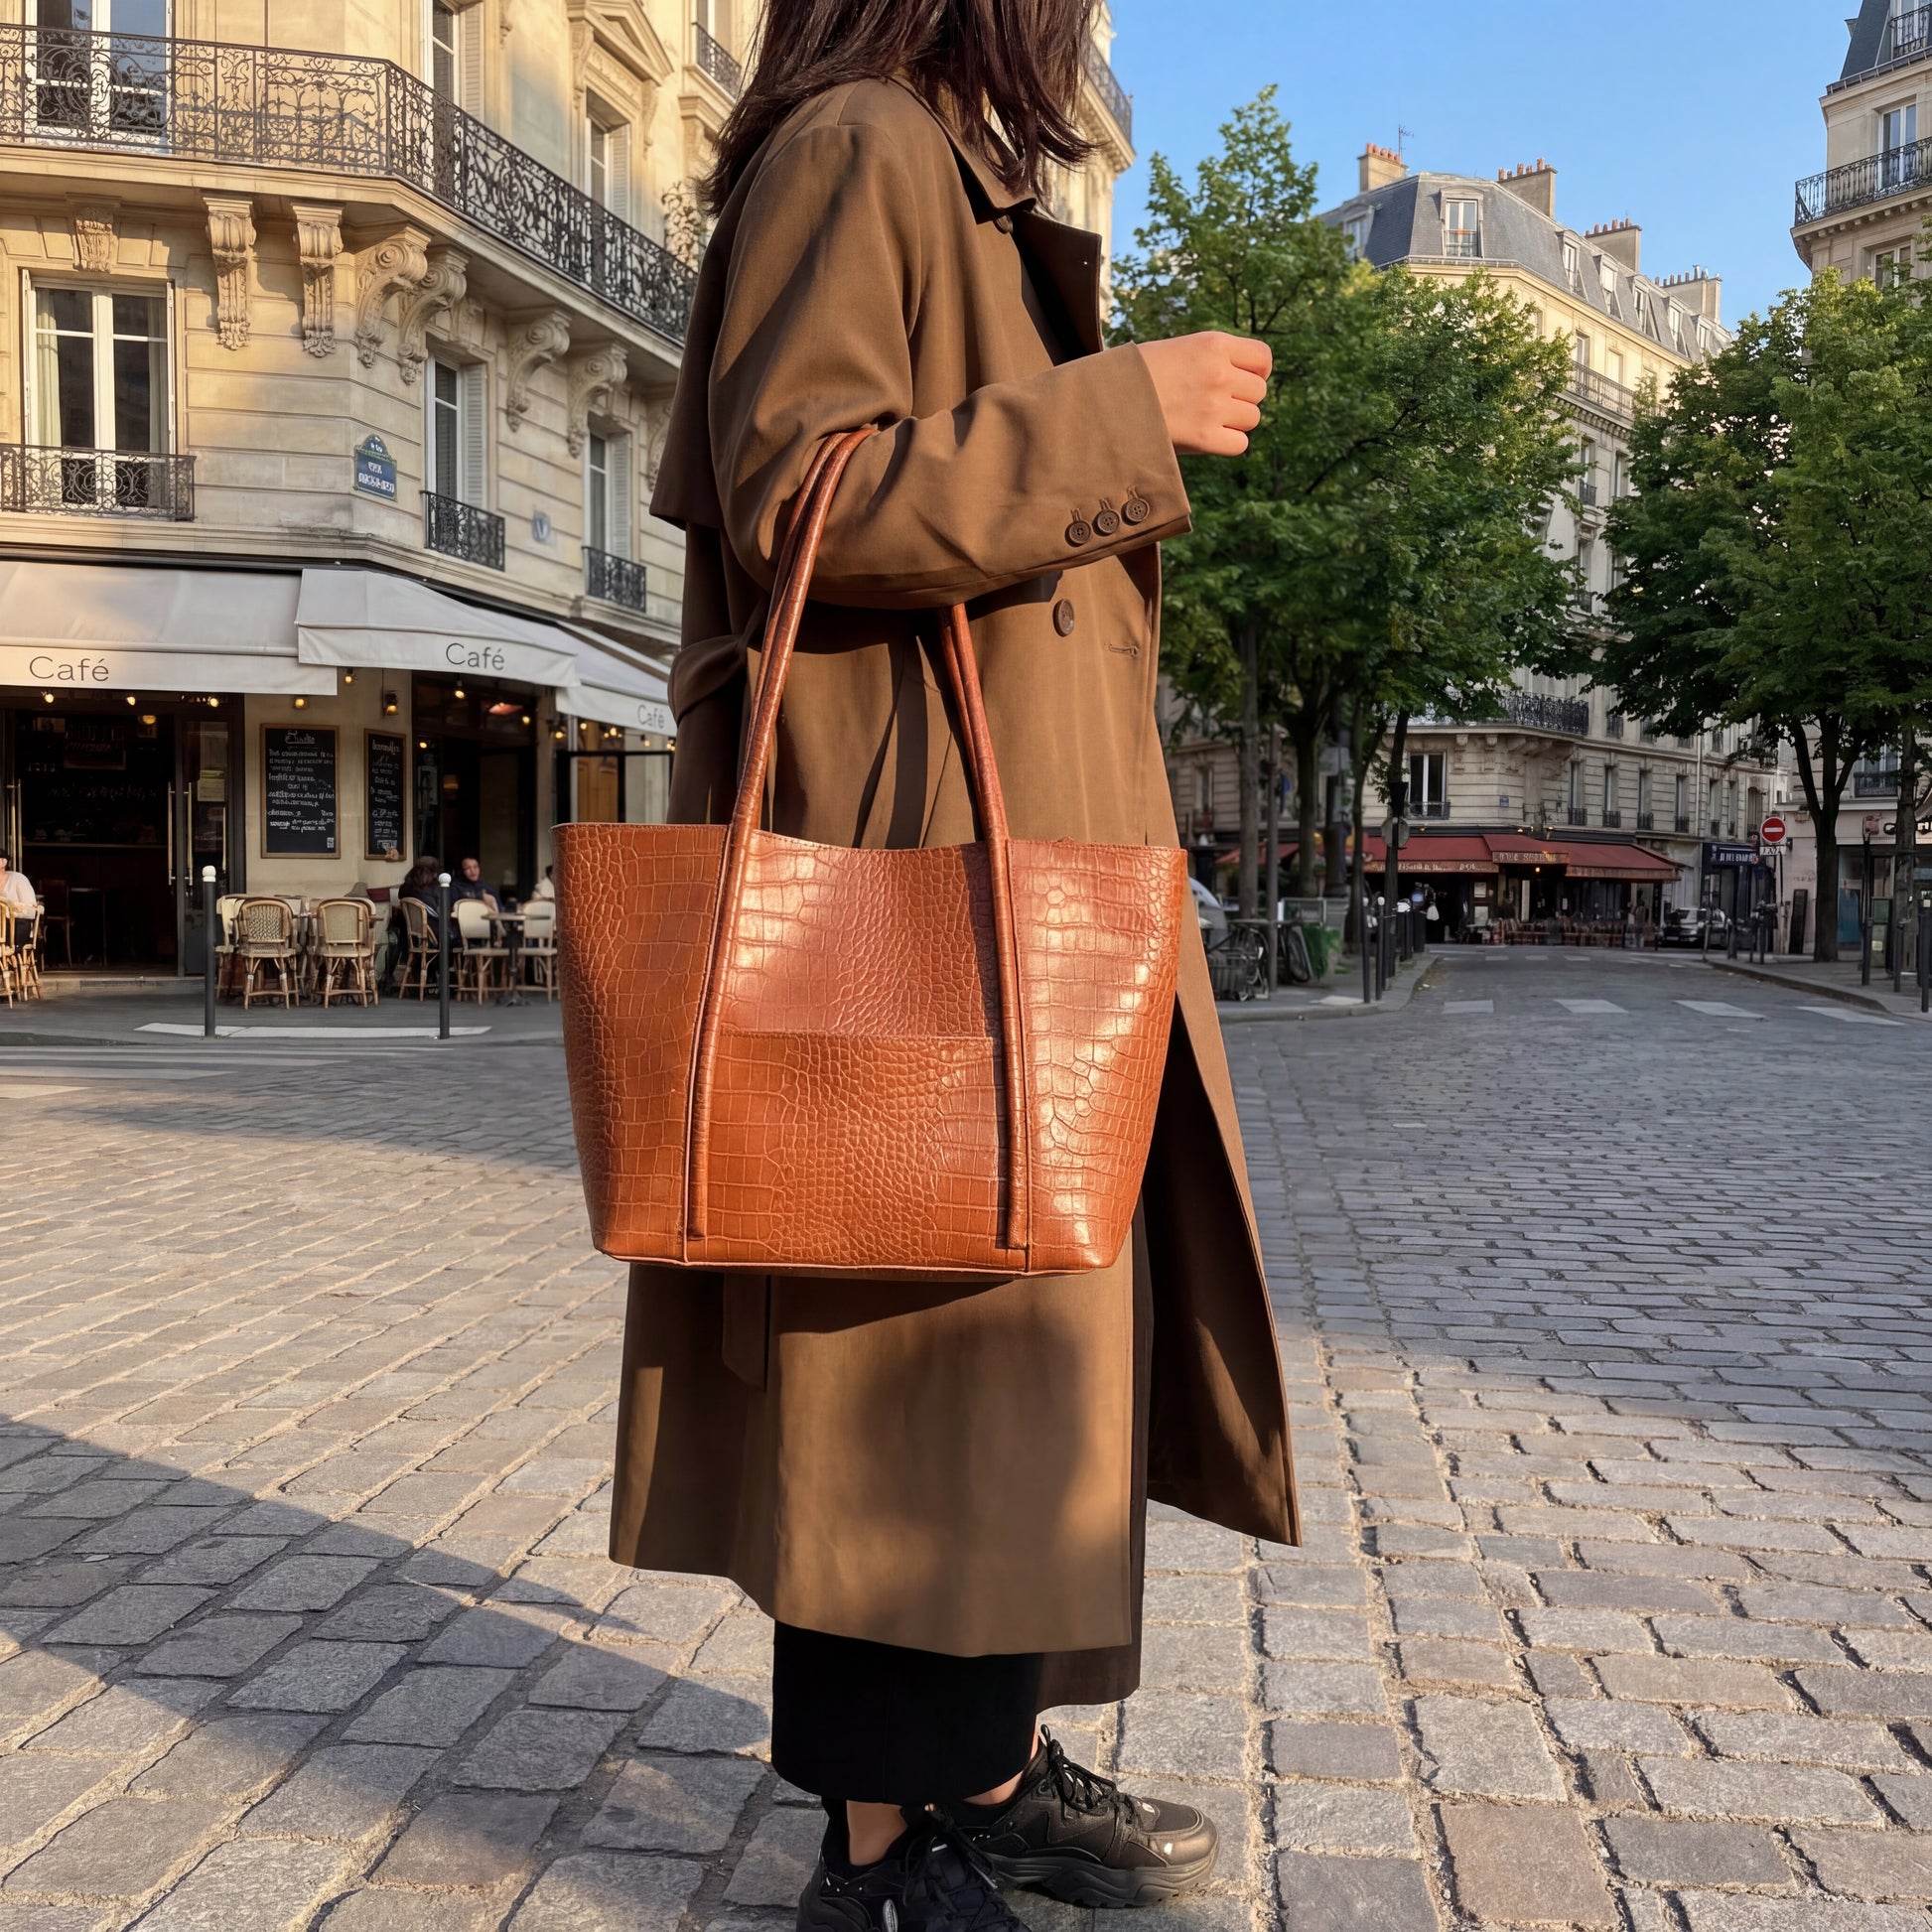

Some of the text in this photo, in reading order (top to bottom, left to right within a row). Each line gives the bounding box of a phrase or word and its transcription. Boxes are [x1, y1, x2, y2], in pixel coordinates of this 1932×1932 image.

[29, 655, 109, 682] Café
[446, 642, 504, 671] Café
[636, 704, 665, 730] Café
